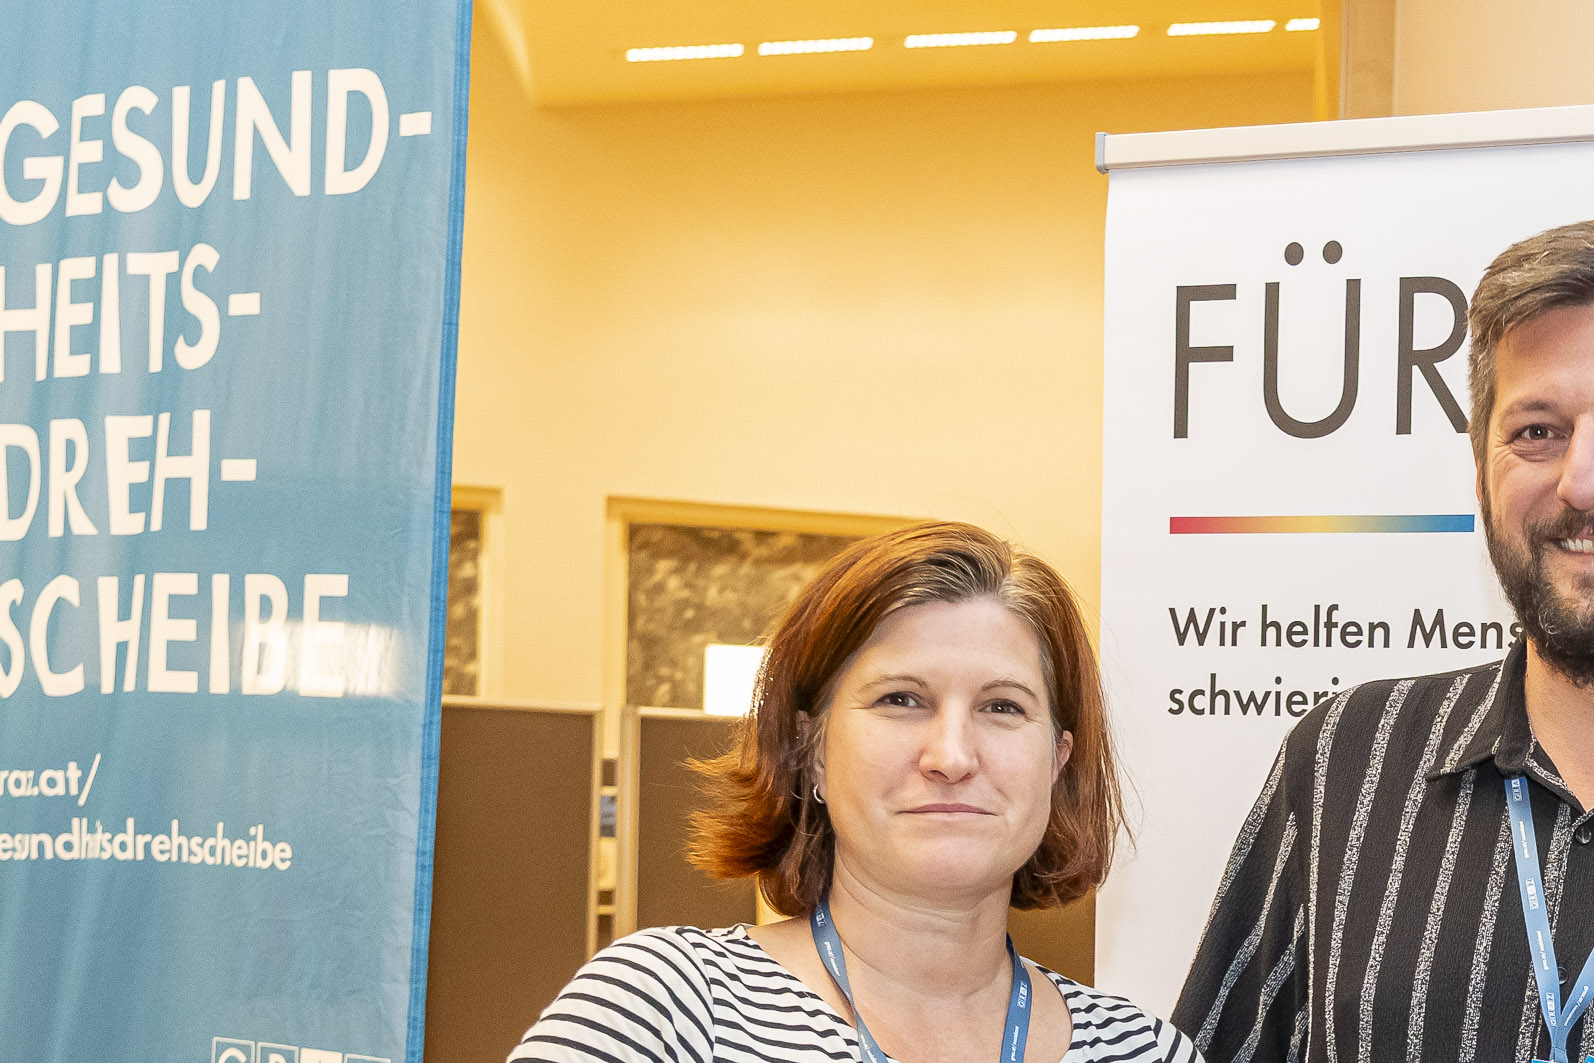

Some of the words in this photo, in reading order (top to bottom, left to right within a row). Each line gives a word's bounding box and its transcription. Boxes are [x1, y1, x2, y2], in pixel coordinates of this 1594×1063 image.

[0, 67, 432, 226] GESUND-
[0, 243, 261, 382] HEITS-
[1173, 240, 1471, 439] FÜR
[0, 409, 257, 541] DREH-
[1168, 605, 1247, 647] Wir
[1260, 603, 1391, 649] helfen
[1167, 672, 1340, 717] schwier
